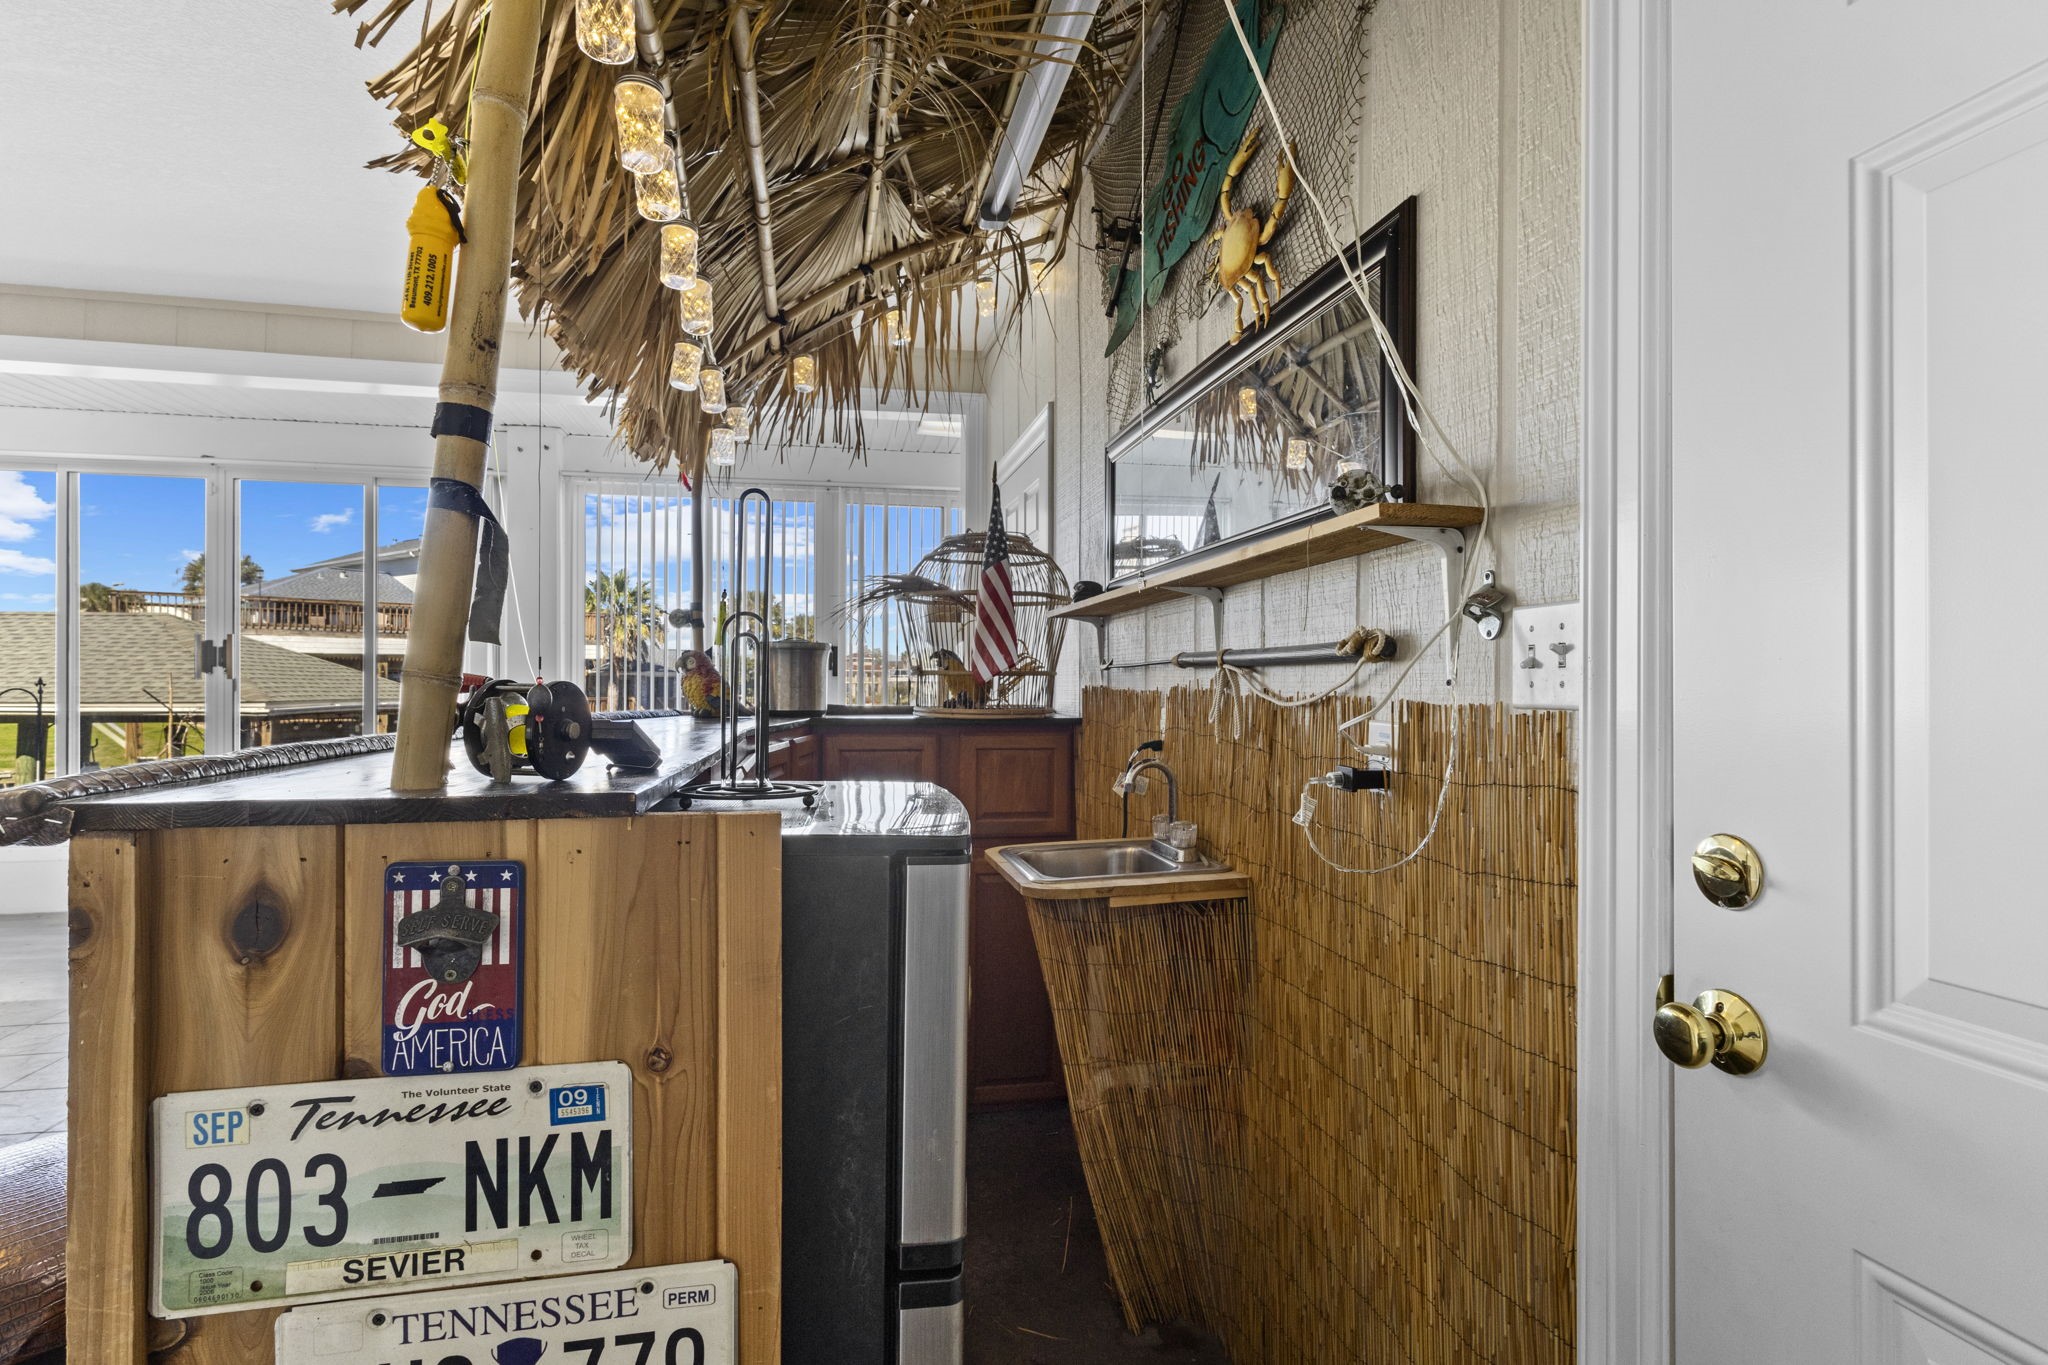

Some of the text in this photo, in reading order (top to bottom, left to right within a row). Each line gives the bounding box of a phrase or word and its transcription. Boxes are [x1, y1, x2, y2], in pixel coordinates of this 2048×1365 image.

[1157, 138, 1205, 259] FISHING
[1162, 151, 1182, 211] GO
[409, 246, 424, 308] Beaumont, TX 77702
[423, 253, 437, 306] 409.212.1005
[401, 914, 489, 939] SELF SERVE
[393, 978, 495, 1041] God
[392, 1026, 507, 1071] AMERICA
[401, 1083, 512, 1099] The Volunteer State
[559, 1088, 588, 1106] 09
[192, 1110, 244, 1146] SEP
[290, 1096, 514, 1142] Tennessee
[186, 1130, 612, 1260] 803 NKM
[570, 1233, 597, 1241] WHEEL
[570, 1250, 596, 1259] DECAL
[575, 1242, 589, 1250] TAX
[342, 1248, 466, 1285] SEVIER
[392, 1287, 639, 1345] TENNESSEE
[667, 1289, 709, 1306] PERM
